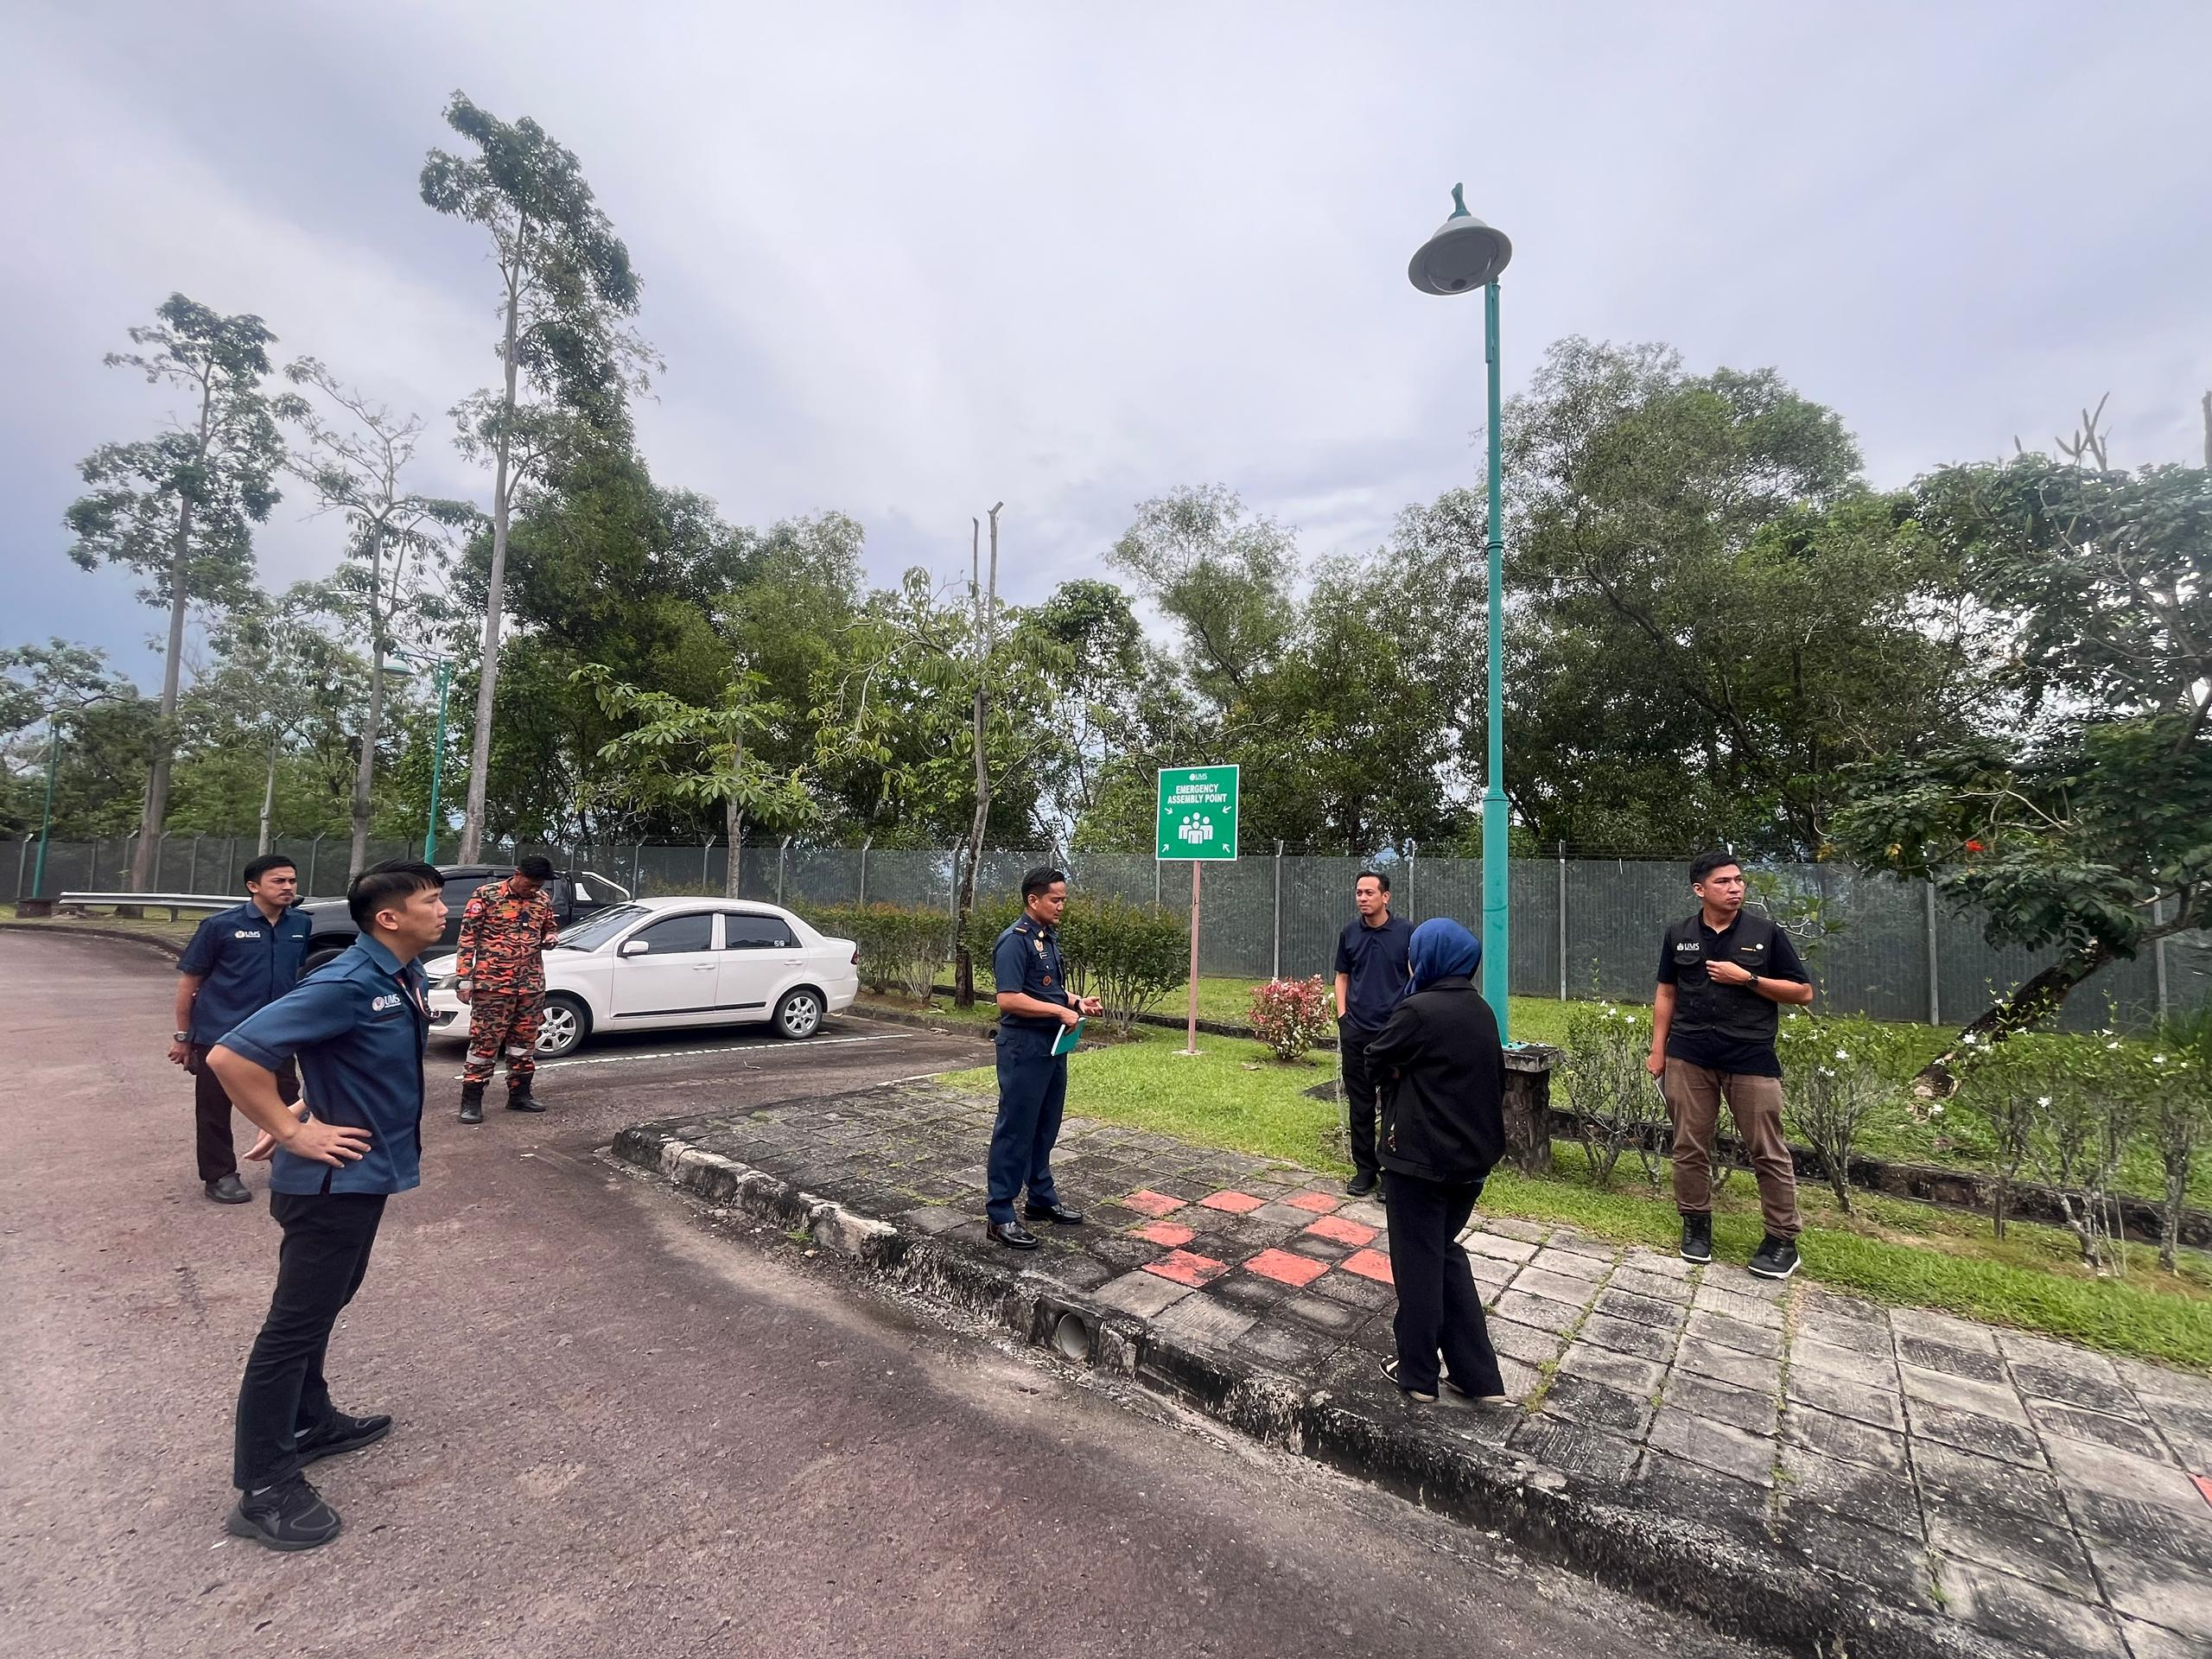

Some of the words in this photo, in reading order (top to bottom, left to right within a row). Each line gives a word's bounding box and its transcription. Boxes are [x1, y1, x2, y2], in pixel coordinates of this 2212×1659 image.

[1176, 784, 1218, 794] EMERGENCY
[1167, 794, 1204, 804] ASSEMBLY
[1205, 793, 1227, 804] POINT
[385, 994, 400, 1006] UMS
